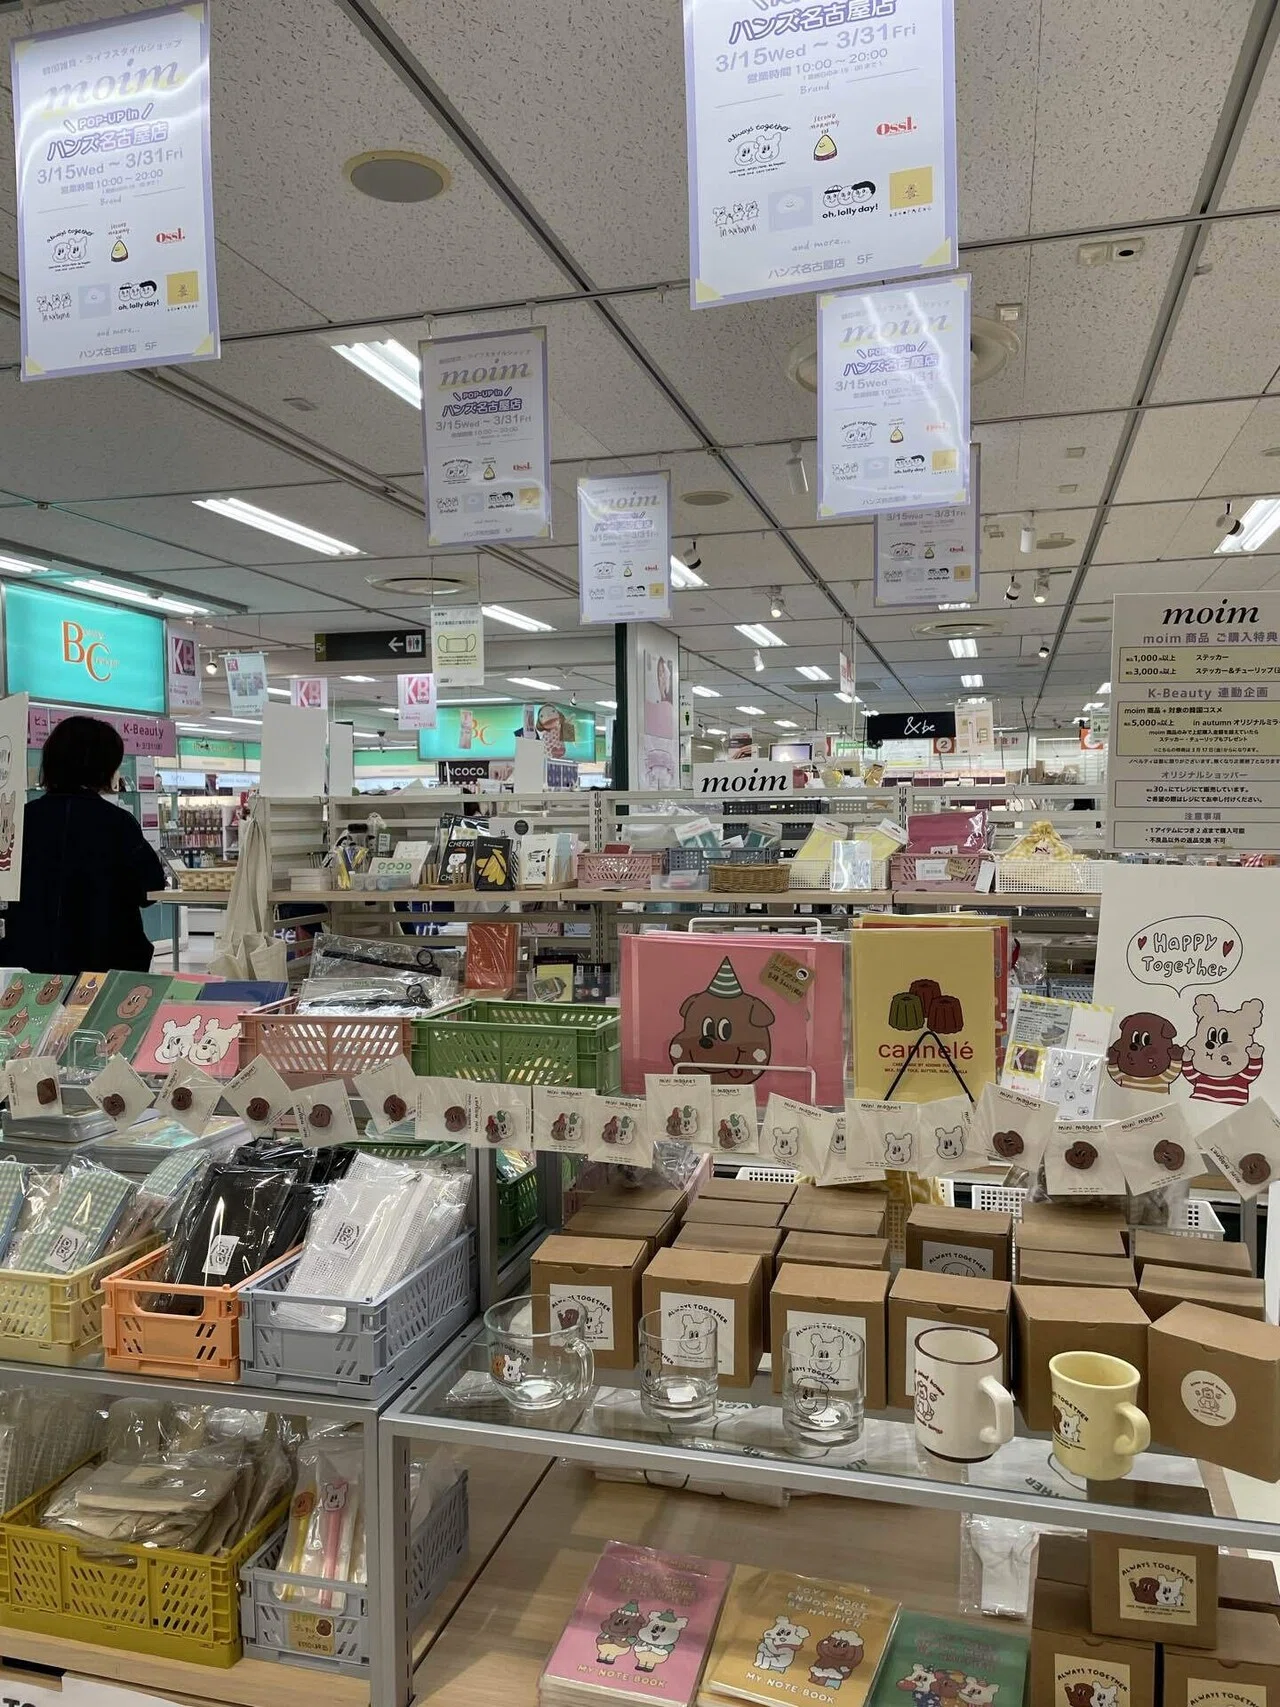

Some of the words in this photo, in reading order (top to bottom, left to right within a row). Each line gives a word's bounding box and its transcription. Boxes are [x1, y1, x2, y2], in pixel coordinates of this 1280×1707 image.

[715, 44, 806, 72] 3/15Wed
[837, 23, 916, 49] 3/31Fri
[796, 59, 831, 75] 10:00
[849, 48, 887, 63] 20:00
[44, 58, 178, 110] moim
[78, 112, 125, 130] POP-UP
[47, 121, 168, 161] ハンズ名古屋店
[727, 126, 754, 143] always
[756, 123, 791, 133] together
[37, 163, 104, 184] 3/15Wed
[126, 147, 183, 169] 3/31Fri
[135, 169, 163, 181] 20:00
[822, 209, 837, 219] oh,
[837, 206, 857, 218] lolly
[857, 203, 879, 214] day!
[67, 228, 94, 237] together
[856, 253, 874, 265] 5F
[129, 302, 143, 311] lolly
[144, 299, 160, 309] day!
[440, 358, 530, 388] moim
[1162, 598, 1260, 625] moim
[1143, 632, 1181, 644] moim
[1185, 632, 1210, 644] 商品
[1216, 631, 1278, 643] ご購入特典
[1196, 654, 1230, 662] ステッカー
[1148, 688, 1212, 700] K-Beauty
[123, 723, 164, 739] K-Beauty
[701, 767, 788, 794] moim
[1184, 812, 1222, 821] 注意事項
[448, 840, 475, 848] CHEERS
[378, 861, 412, 870] GOOD
[1141, 956, 1228, 978] Together
[878, 1041, 974, 1060] cannelé
[784, 1102, 797, 1110] mini
[999, 1091, 1014, 1100] mini
[1016, 1094, 1041, 1109] magnet
[1075, 1123, 1102, 1133] magnet
[1121, 1121, 1138, 1130] mini
[1141, 1112, 1164, 1126] magnet
[1210, 1147, 1230, 1170] magnet
[929, 1252, 952, 1264] ALWAYS
[954, 1252, 987, 1272] TOGETHER
[576, 1294, 611, 1313] TOGETHER
[692, 1303, 728, 1324] TOGETHER
[807, 1367, 840, 1386] TOGETHER
[1121, 1562, 1151, 1576] ALWAYS
[1152, 1562, 1194, 1584] TOGETHER
[808, 1608, 862, 1628] HAPPIER
[835, 1604, 869, 1620] MORE
[577, 1663, 595, 1673] MY
[599, 1666, 630, 1682] NOTE
[633, 1675, 666, 1689] BOOK
[1057, 1667, 1085, 1681] ALWAYS
[1087, 1667, 1128, 1692] TOGETHER
[745, 1671, 763, 1684] MY
[767, 1677, 799, 1694] NOTE
[802, 1688, 835, 1705] BOOK
[1190, 1691, 1219, 1706] ALWAYS
